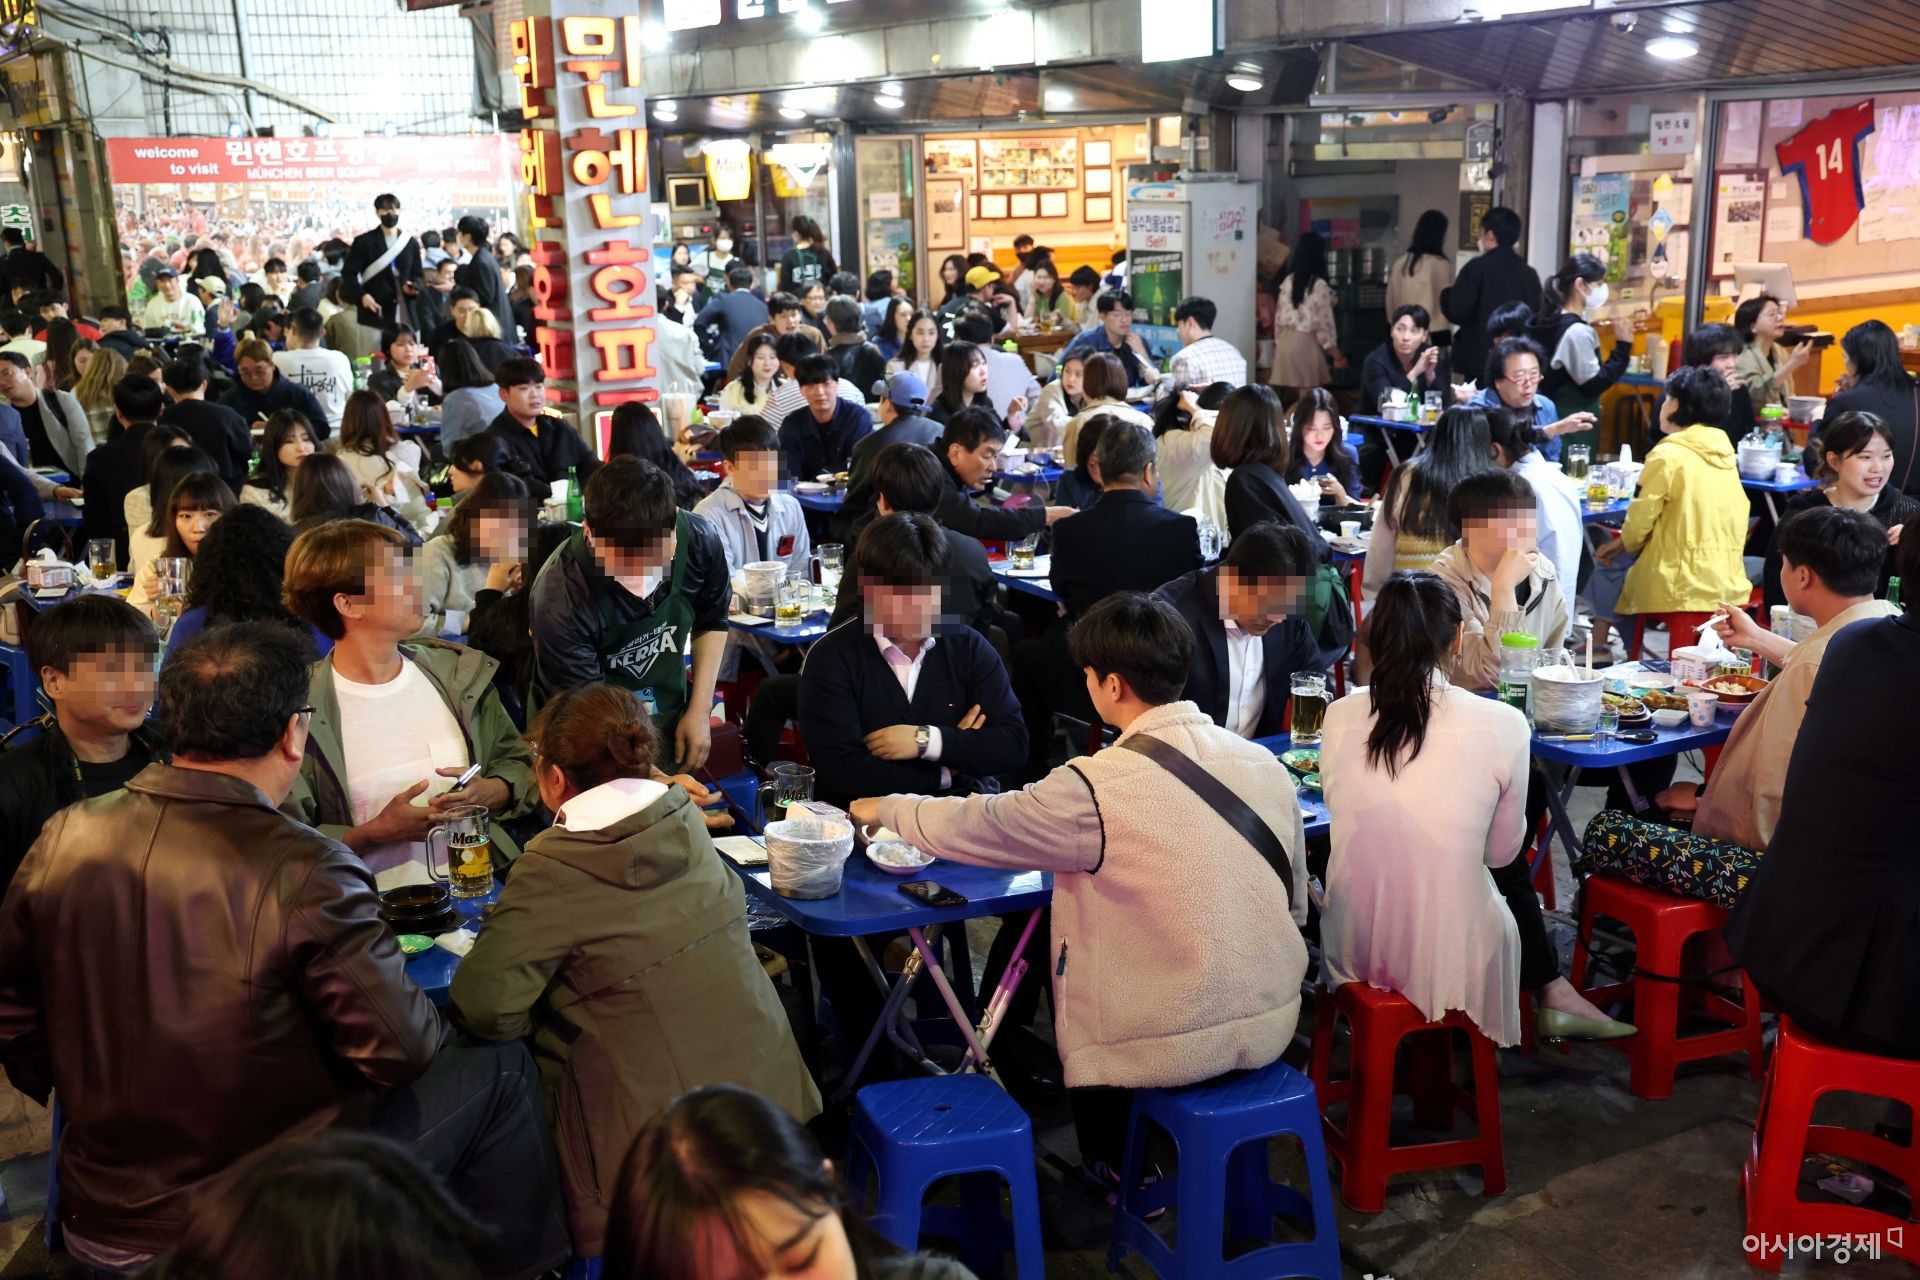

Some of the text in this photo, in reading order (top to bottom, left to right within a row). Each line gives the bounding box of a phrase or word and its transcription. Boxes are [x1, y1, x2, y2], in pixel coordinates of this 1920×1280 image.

[134, 146, 199, 159] welcome
[1476, 141, 1490, 156] 14
[1815, 137, 1844, 181] 14
[170, 163, 219, 176] to visit
[562, 15, 659, 405] 뮌헨호프
[607, 630, 678, 668] TERRA
